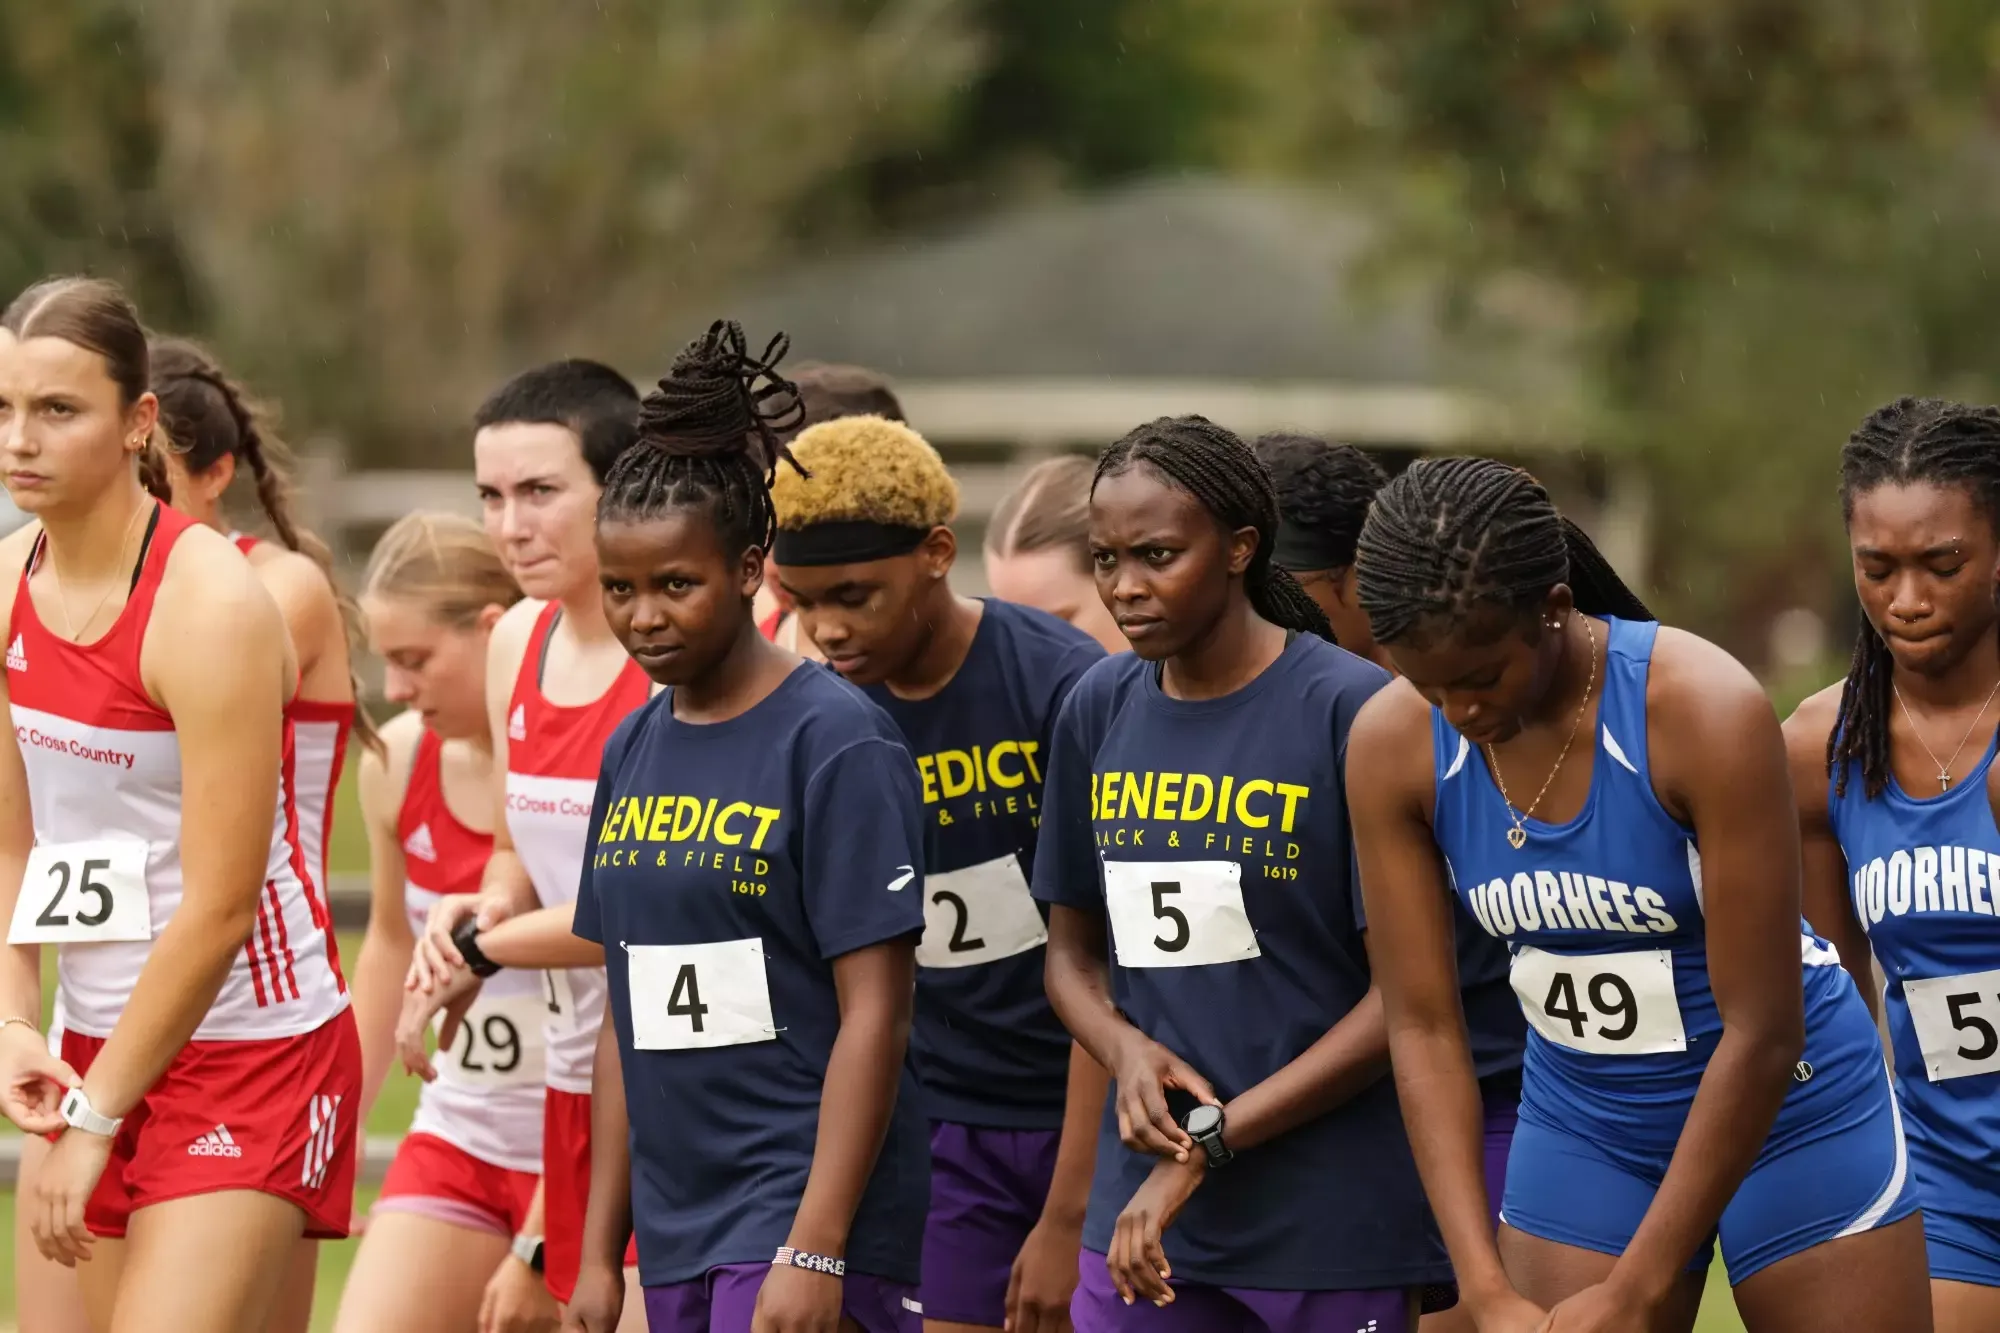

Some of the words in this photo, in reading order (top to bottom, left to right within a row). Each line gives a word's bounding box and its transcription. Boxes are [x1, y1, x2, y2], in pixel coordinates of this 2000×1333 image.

[30, 729, 67, 753] Cross
[69, 740, 135, 770] Country
[517, 795, 556, 814] Cross
[939, 809, 954, 826] &
[656, 850, 667, 867] &
[685, 851, 769, 876] FIELD
[1167, 831, 1180, 847] &
[1205, 833, 1300, 859] FIELD
[35, 859, 116, 927] 25
[731, 880, 767, 896] 1619
[1263, 865, 1298, 880] 1619
[932, 890, 986, 952] 2
[1151, 881, 1190, 953] 5
[1468, 870, 1678, 937] VOORHEES
[667, 964, 709, 1033] 4
[1543, 972, 1638, 1041] 49
[461, 1015, 521, 1073] 29
[1946, 992, 2000, 1060] 5
[187, 1143, 242, 1158] adidas
